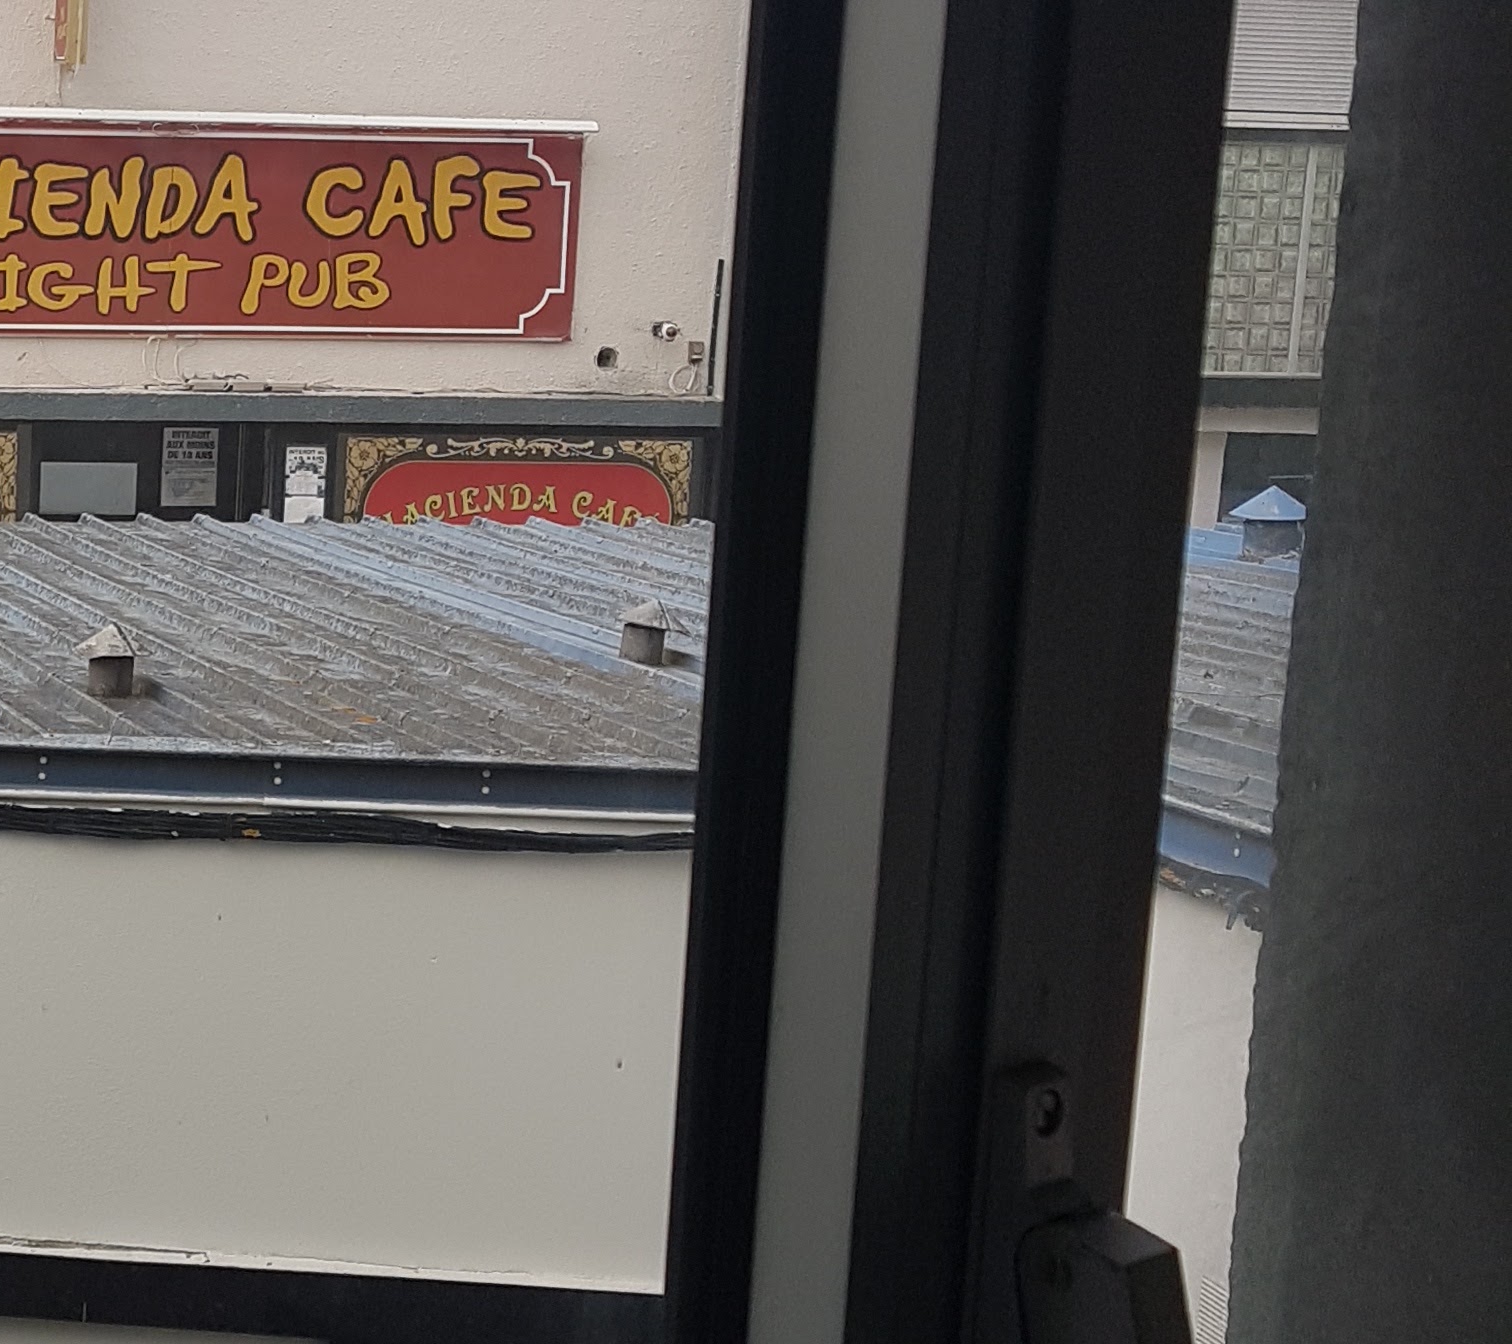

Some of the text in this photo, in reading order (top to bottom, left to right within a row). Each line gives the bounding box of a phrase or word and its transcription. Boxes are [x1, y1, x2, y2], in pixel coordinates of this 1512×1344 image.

[304, 154, 542, 247] CAFE
[238, 251, 391, 316] PUB
[572, 491, 660, 527] CAF
